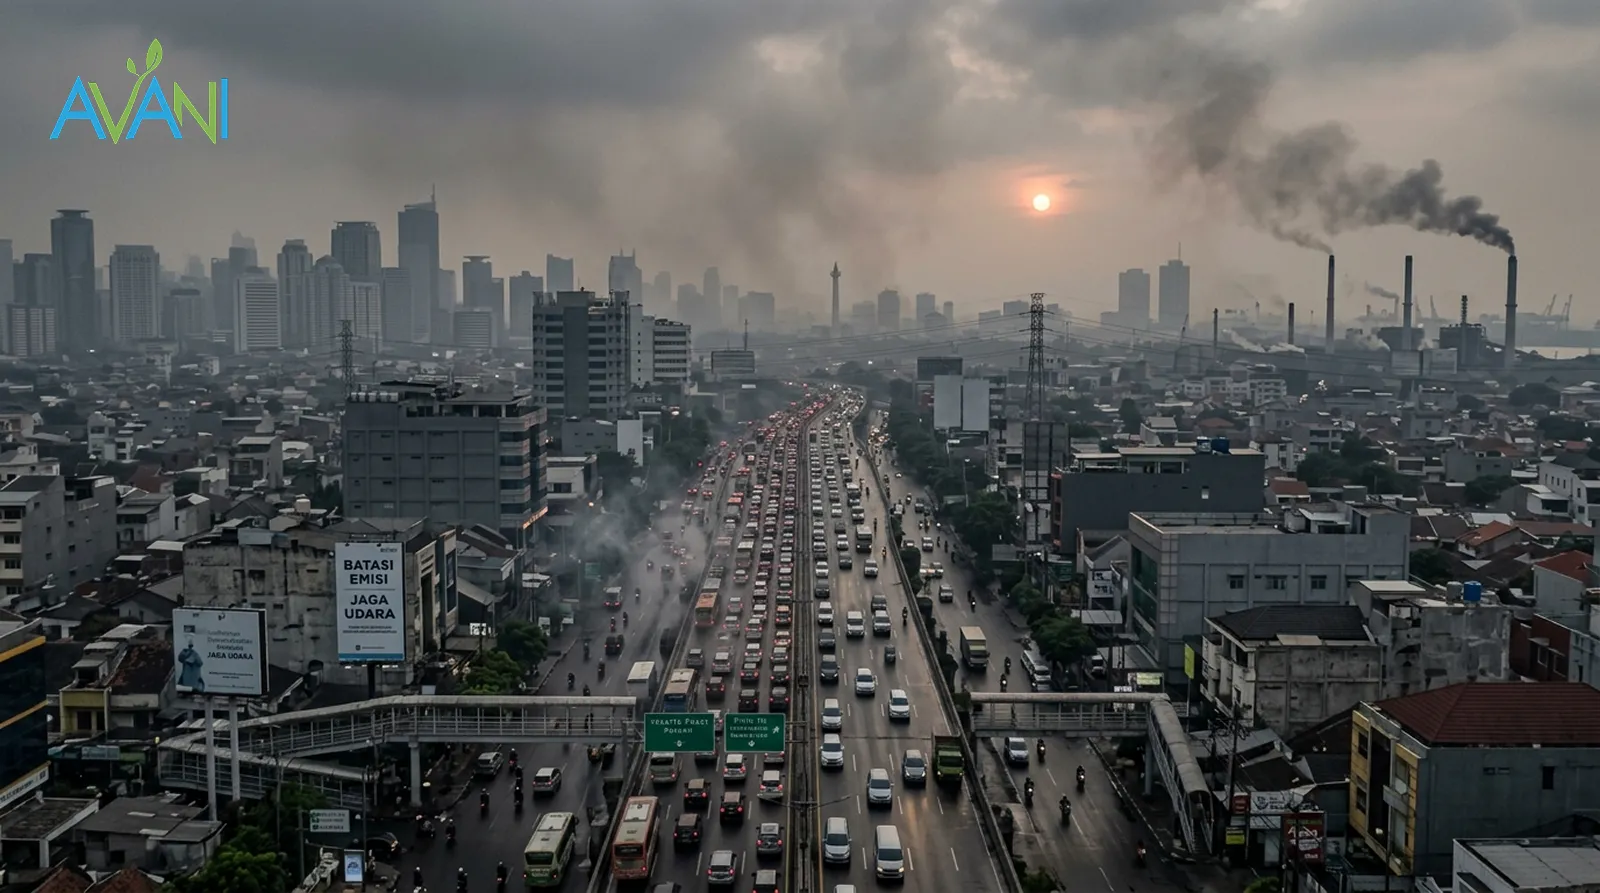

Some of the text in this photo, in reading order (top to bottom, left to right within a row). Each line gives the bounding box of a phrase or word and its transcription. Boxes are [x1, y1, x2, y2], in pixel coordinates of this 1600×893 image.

[343, 559, 394, 571] BATASI
[349, 573, 388, 585] EMISI
[350, 594, 389, 606] JAGA
[344, 608, 396, 620] UDARA
